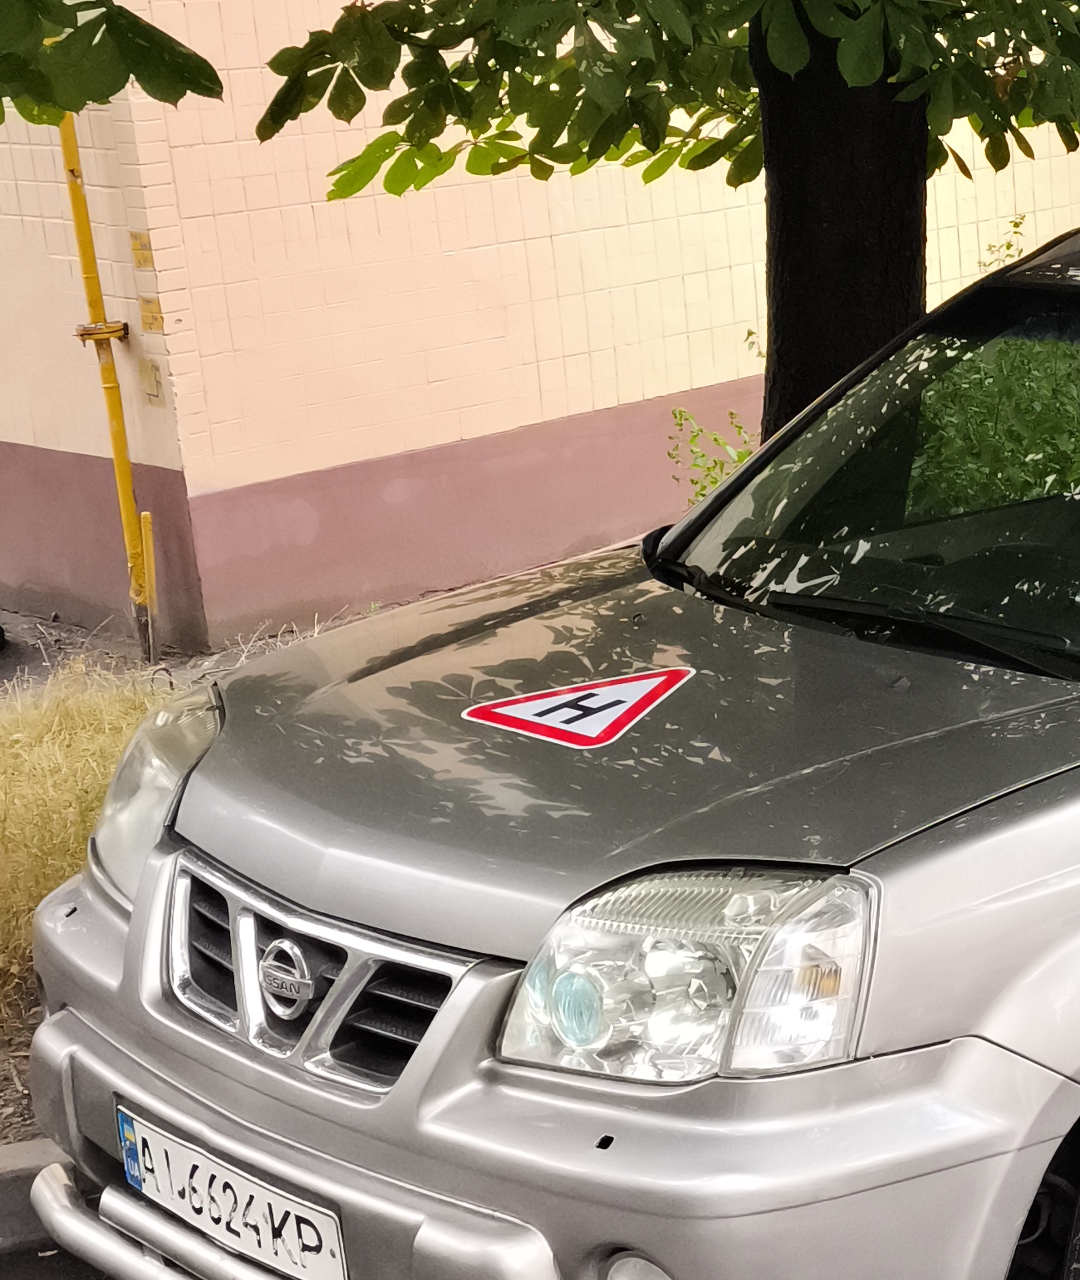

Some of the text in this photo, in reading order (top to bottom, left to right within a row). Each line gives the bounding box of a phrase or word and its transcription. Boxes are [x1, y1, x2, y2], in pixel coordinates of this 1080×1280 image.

[531, 692, 629, 726] Н
[264, 973, 301, 995] SSAN
[127, 1157, 141, 1180] UA
